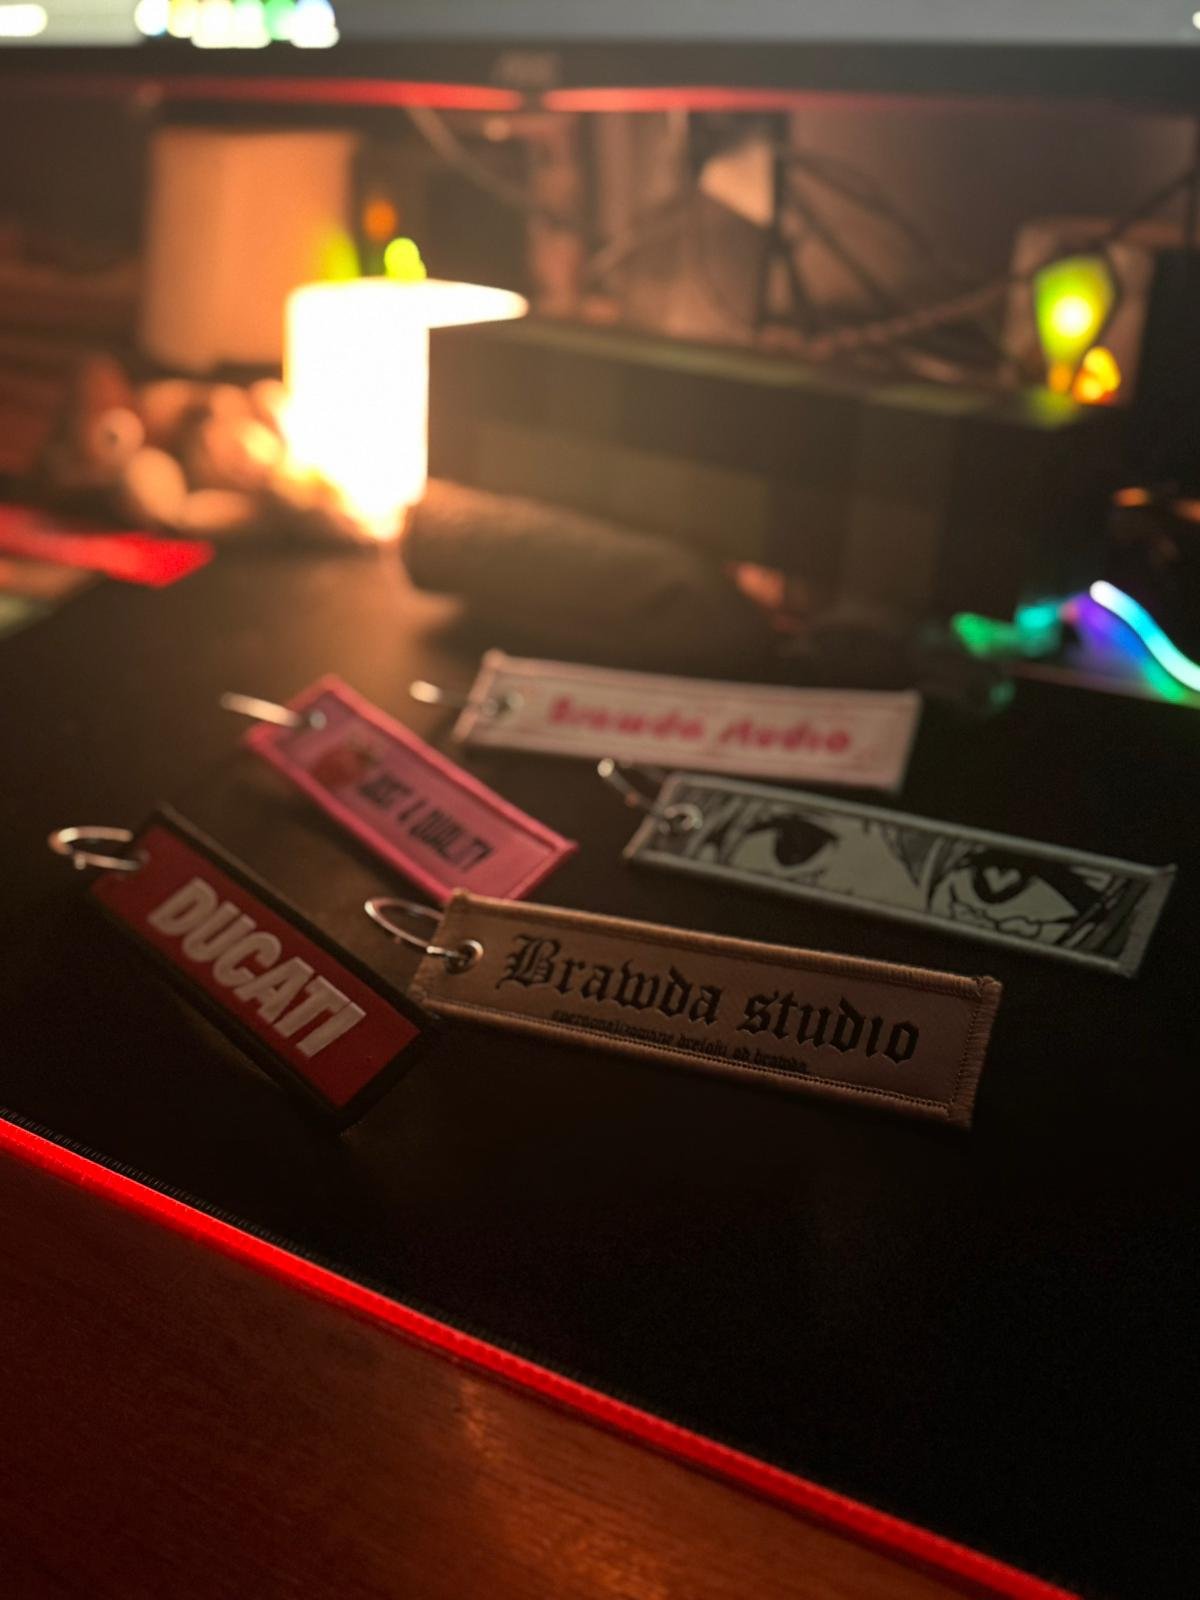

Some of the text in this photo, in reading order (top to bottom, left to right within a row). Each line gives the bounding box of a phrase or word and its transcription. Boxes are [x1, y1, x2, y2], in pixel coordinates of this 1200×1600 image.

[146, 876, 367, 1058] DUCATI
[496, 933, 920, 1065] Brawda studio
